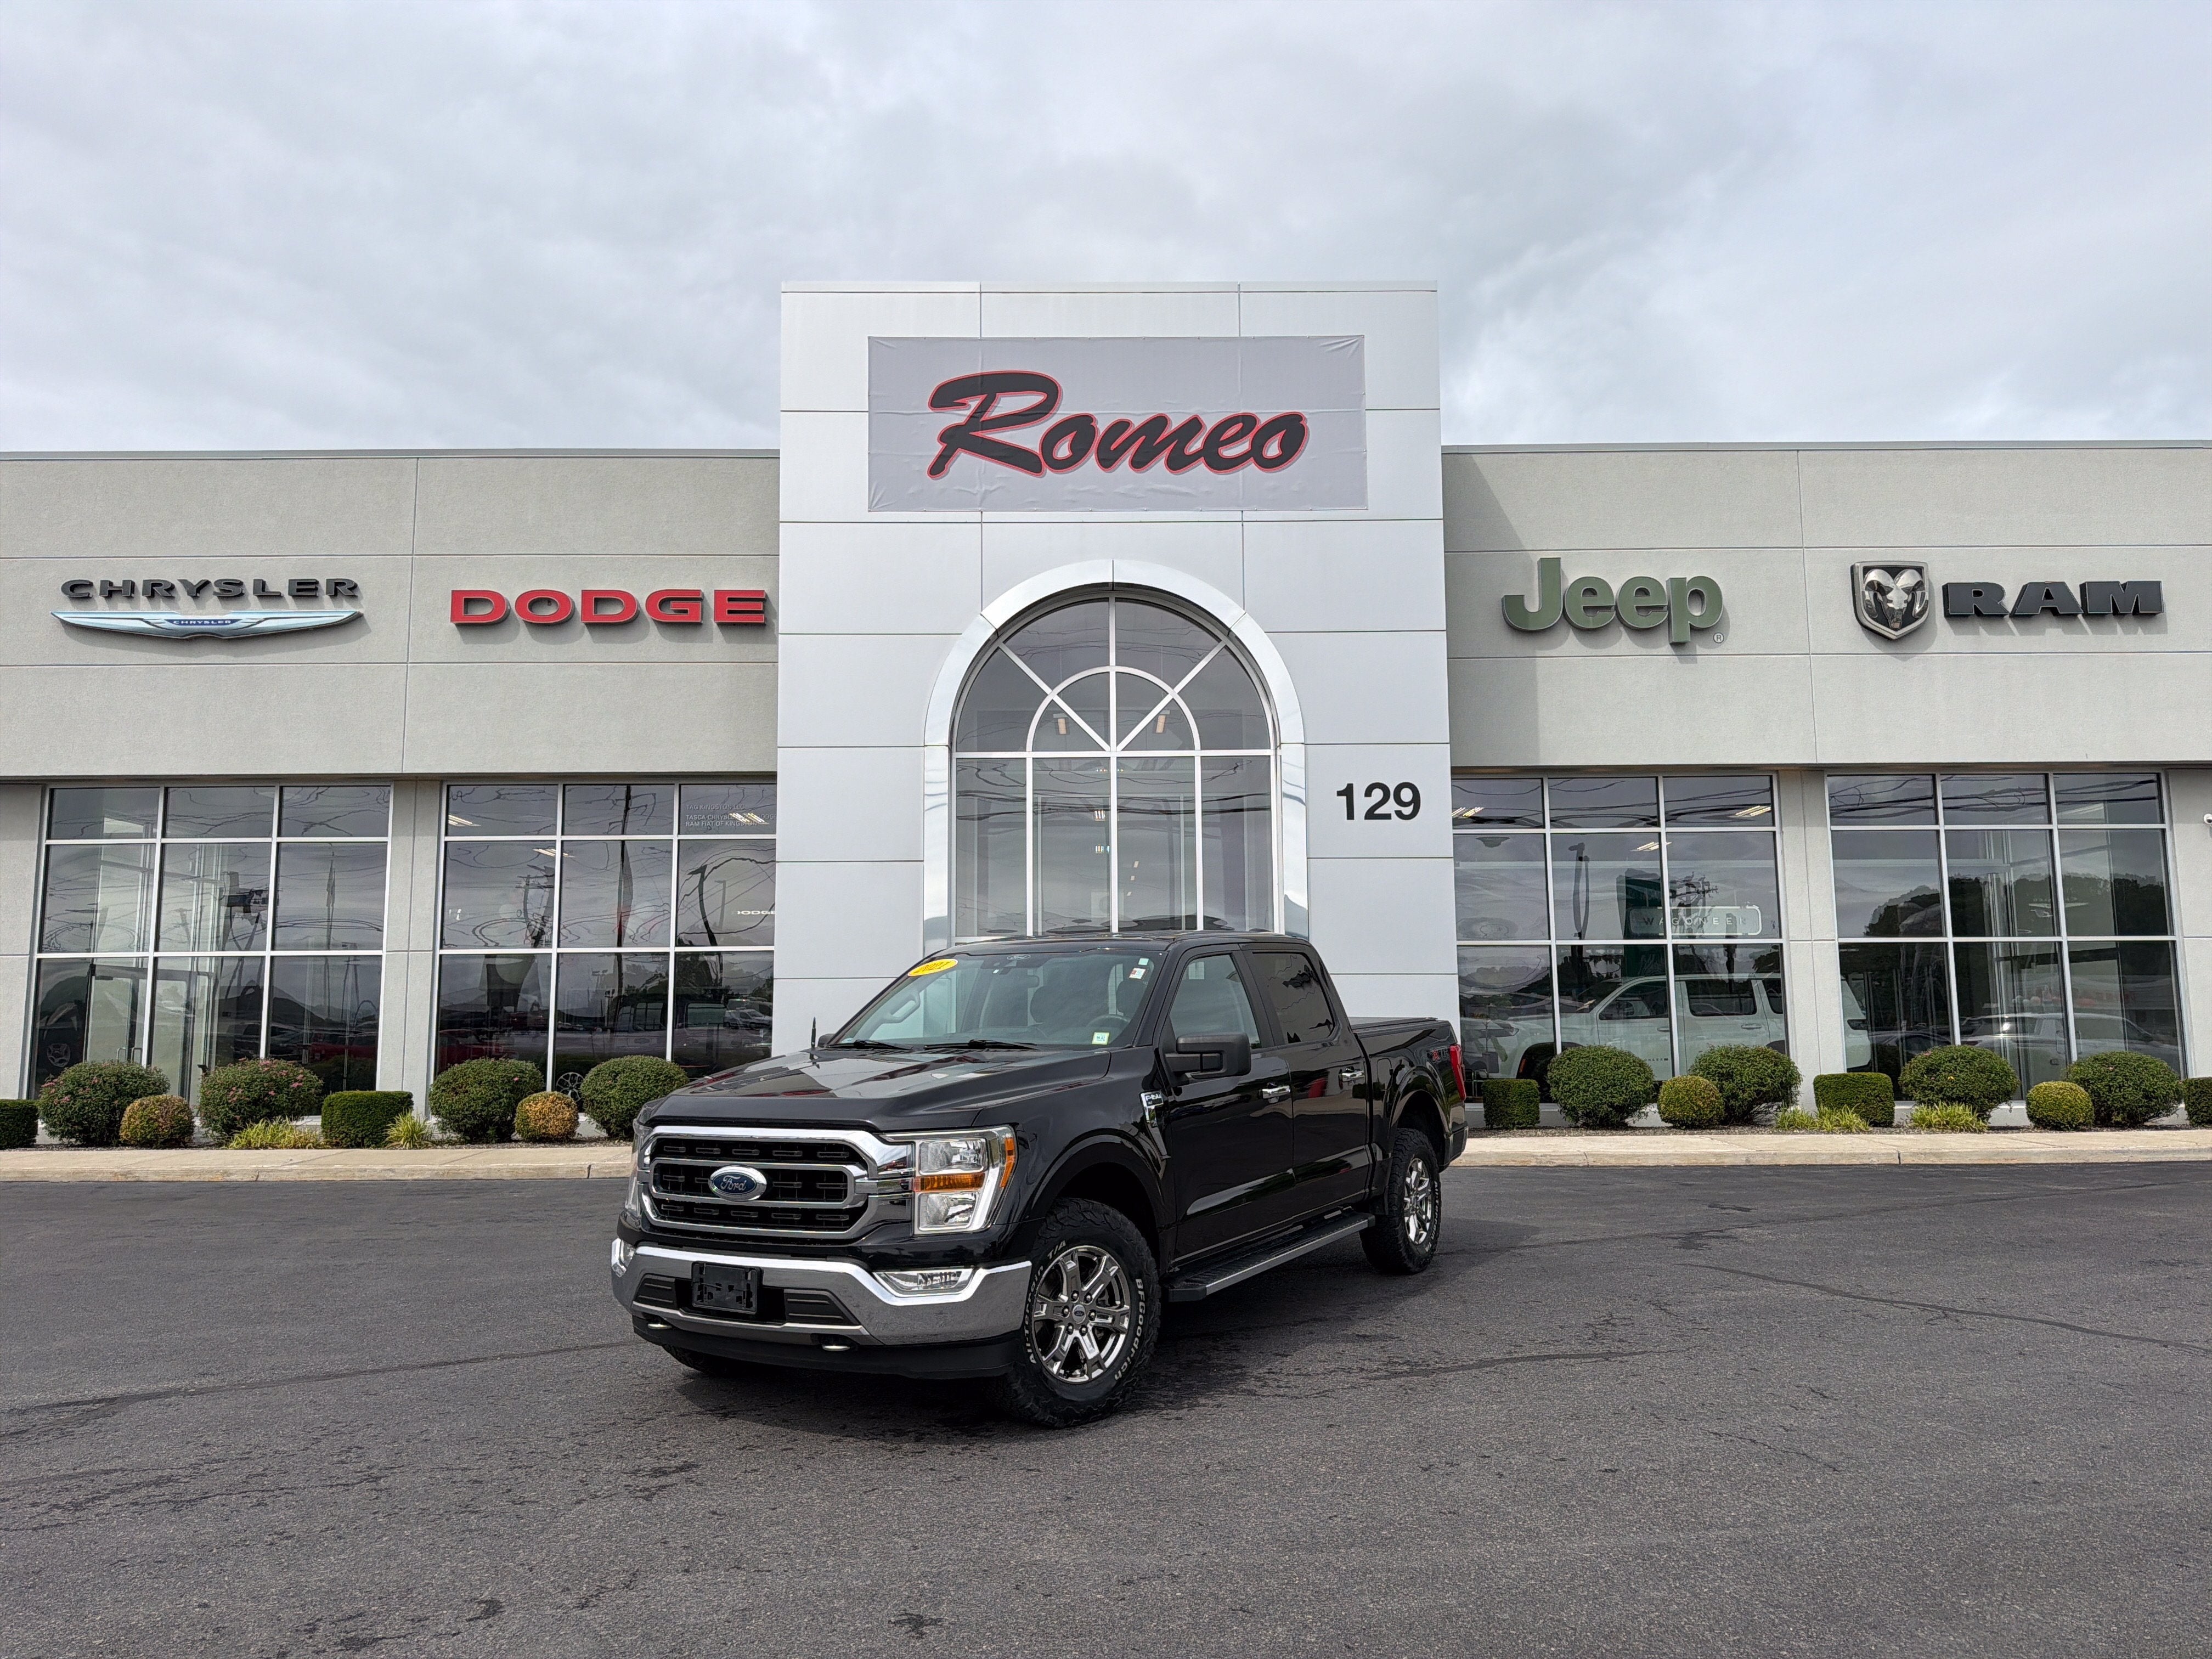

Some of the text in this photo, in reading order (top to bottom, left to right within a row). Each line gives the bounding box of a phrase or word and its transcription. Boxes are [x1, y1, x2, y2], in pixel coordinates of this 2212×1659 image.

[928, 370, 1308, 478] Romeo
[61, 578, 359, 598] CHRYSLER
[1501, 557, 1723, 644] Jeep
[1942, 580, 2164, 616] RAM
[450, 589, 767, 624] DODGE
[1336, 782, 1421, 820] 129
[720, 1175, 747, 1191] Ford
[1047, 1240, 1066, 1260] T/A
[1114, 1278, 1146, 1380] BFGoodrich
